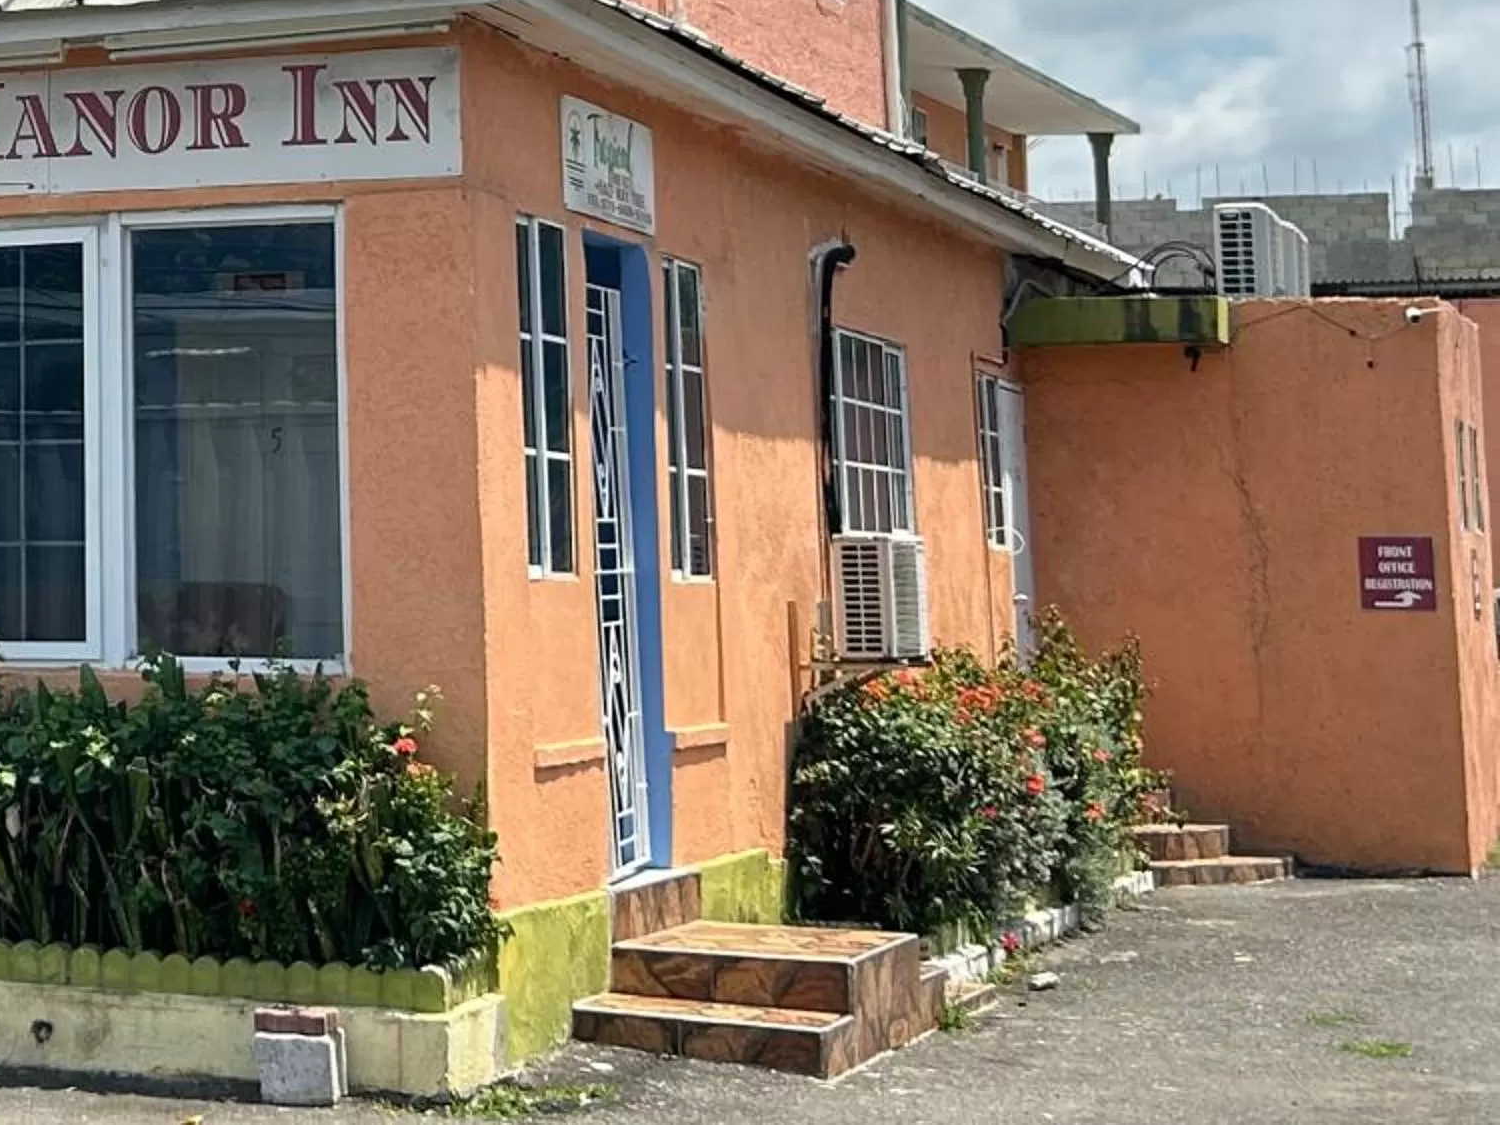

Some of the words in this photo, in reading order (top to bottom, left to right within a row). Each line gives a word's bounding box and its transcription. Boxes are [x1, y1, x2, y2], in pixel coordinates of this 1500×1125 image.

[282, 64, 437, 145] INN
[1377, 546, 1413, 557] FRONT
[1378, 562, 1415, 573] OFFICE
[1364, 578, 1433, 590] REGISTRATION
